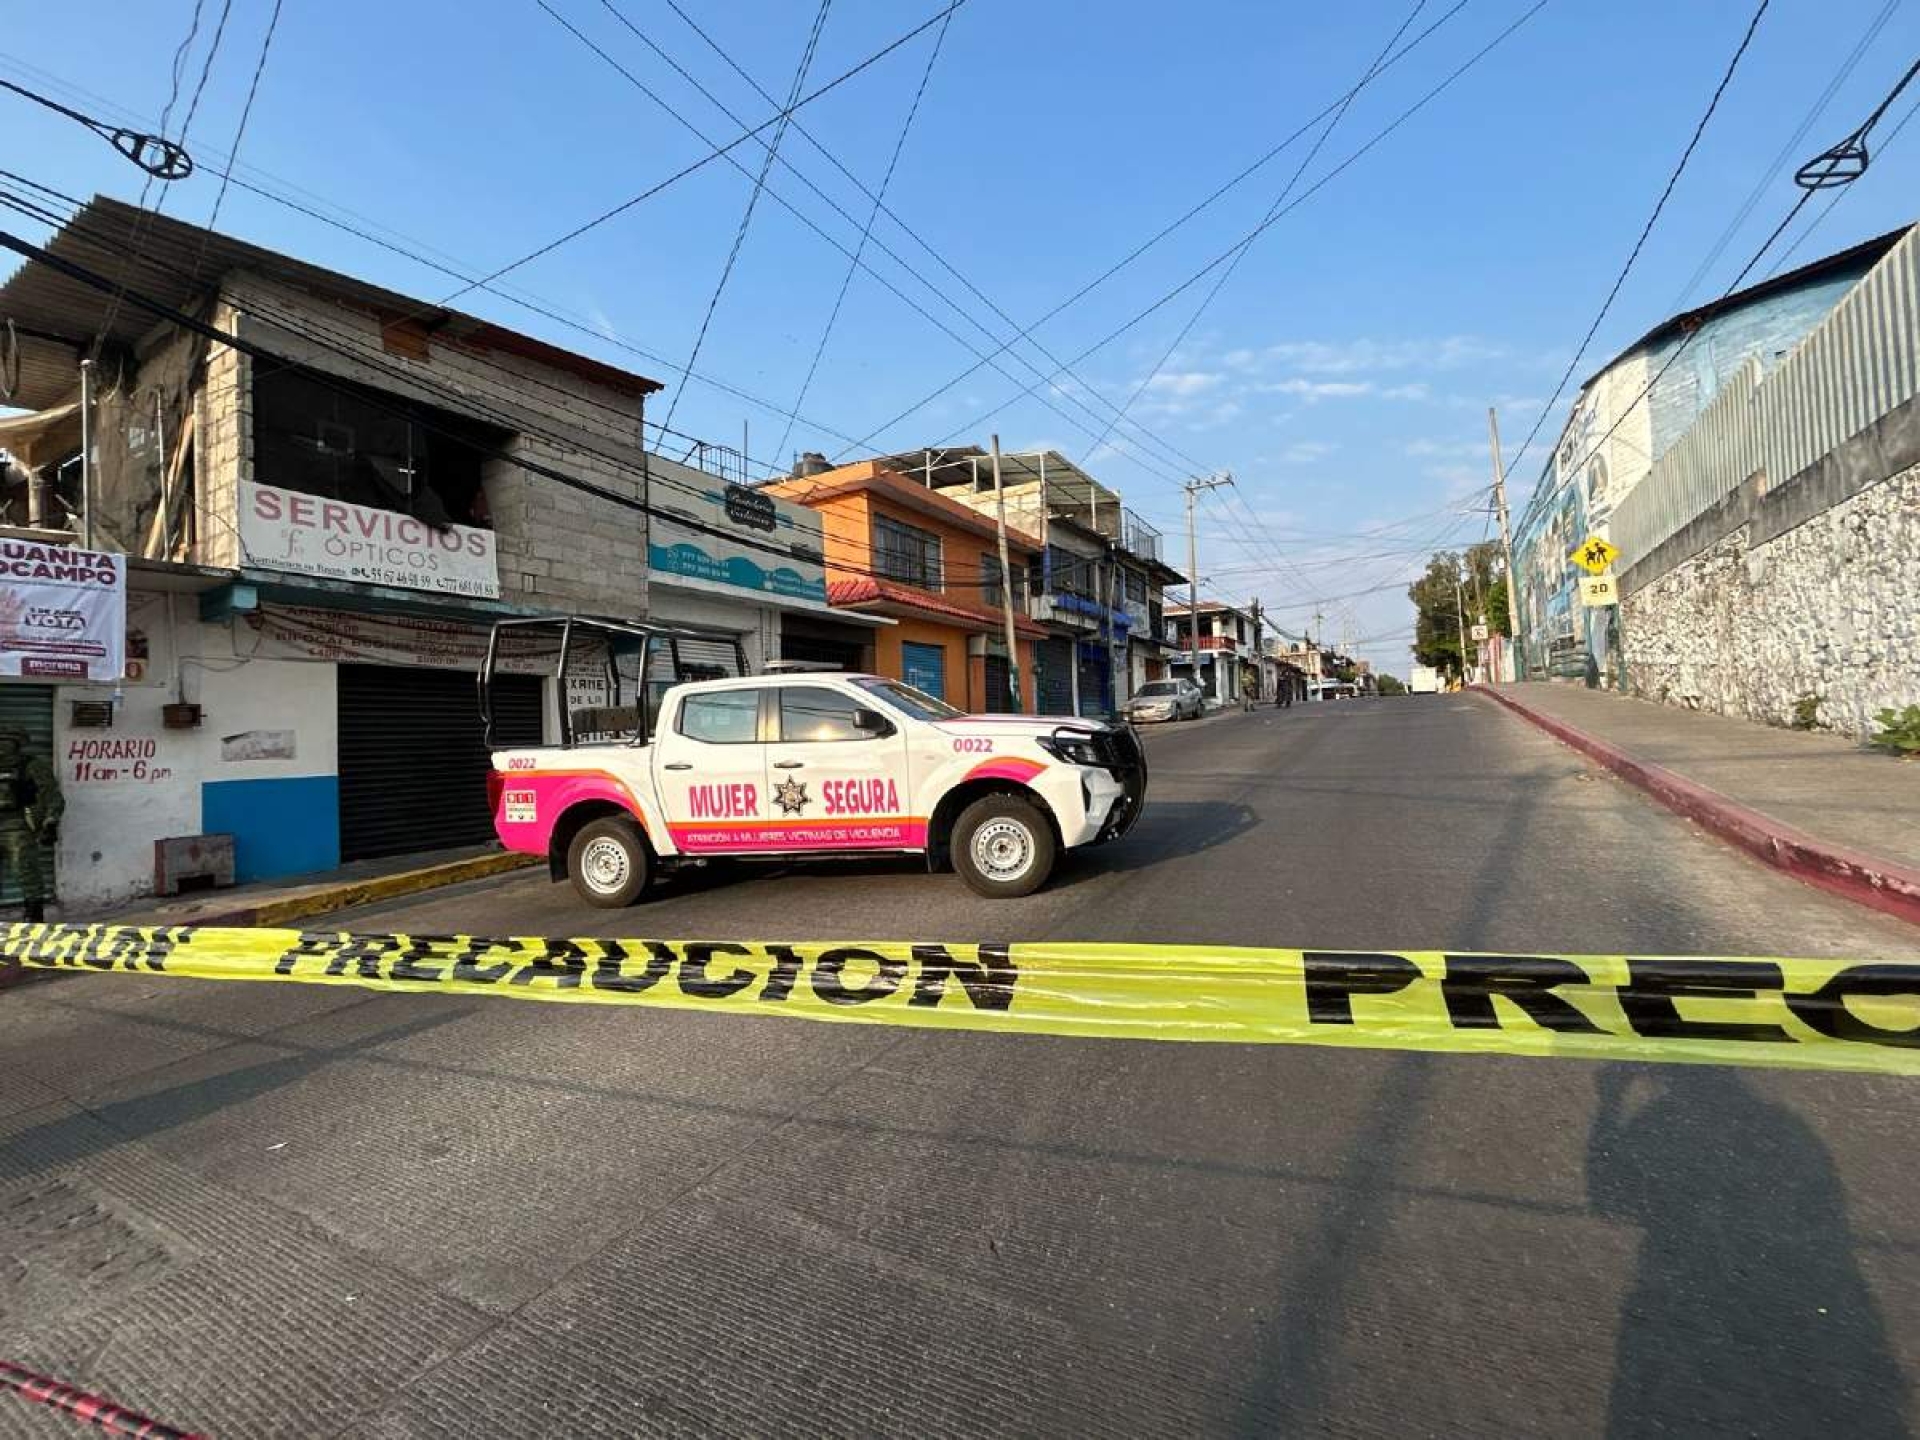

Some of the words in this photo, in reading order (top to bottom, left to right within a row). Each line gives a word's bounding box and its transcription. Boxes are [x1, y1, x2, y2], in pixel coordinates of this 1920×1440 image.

[255, 490, 486, 557] SERVICIOS
[0, 543, 115, 570] UANITA
[324, 534, 438, 571] ÓPTICOS
[26, 613, 85, 629] VOTA
[29, 660, 81, 672] morena
[69, 740, 156, 760] HORARIO
[953, 738, 993, 753] 0022
[509, 758, 537, 769] 0022
[689, 783, 759, 818] MUJER
[823, 778, 900, 816] SEGURA
[850, 827, 900, 840] VIOLENCIA
[275, 931, 1014, 1011] PRECAUCION
[1303, 951, 1920, 1048] PREC
